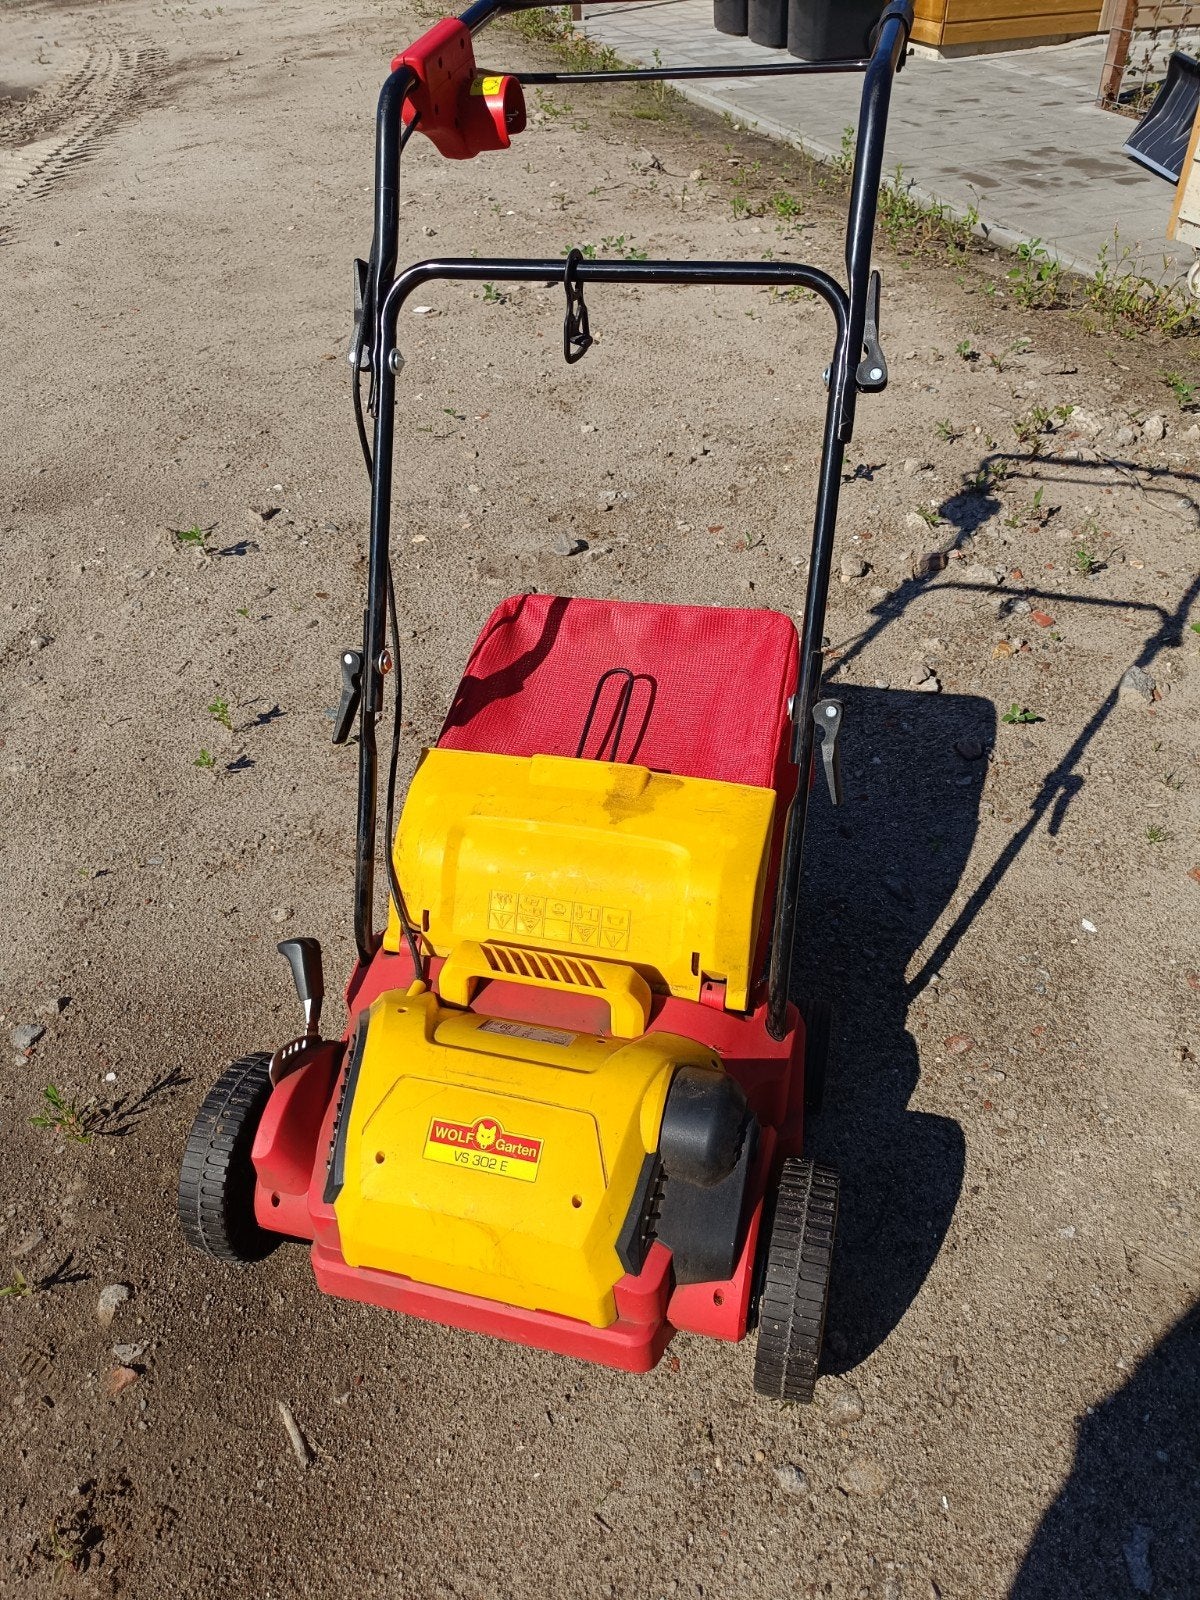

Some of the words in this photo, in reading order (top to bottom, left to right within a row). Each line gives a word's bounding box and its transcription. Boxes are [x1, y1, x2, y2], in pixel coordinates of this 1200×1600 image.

[435, 1125, 475, 1144] WOLF
[495, 1138, 537, 1157] Garten
[454, 1150, 469, 1164] VS
[472, 1155, 497, 1169] 302
[499, 1160, 508, 1172] E
